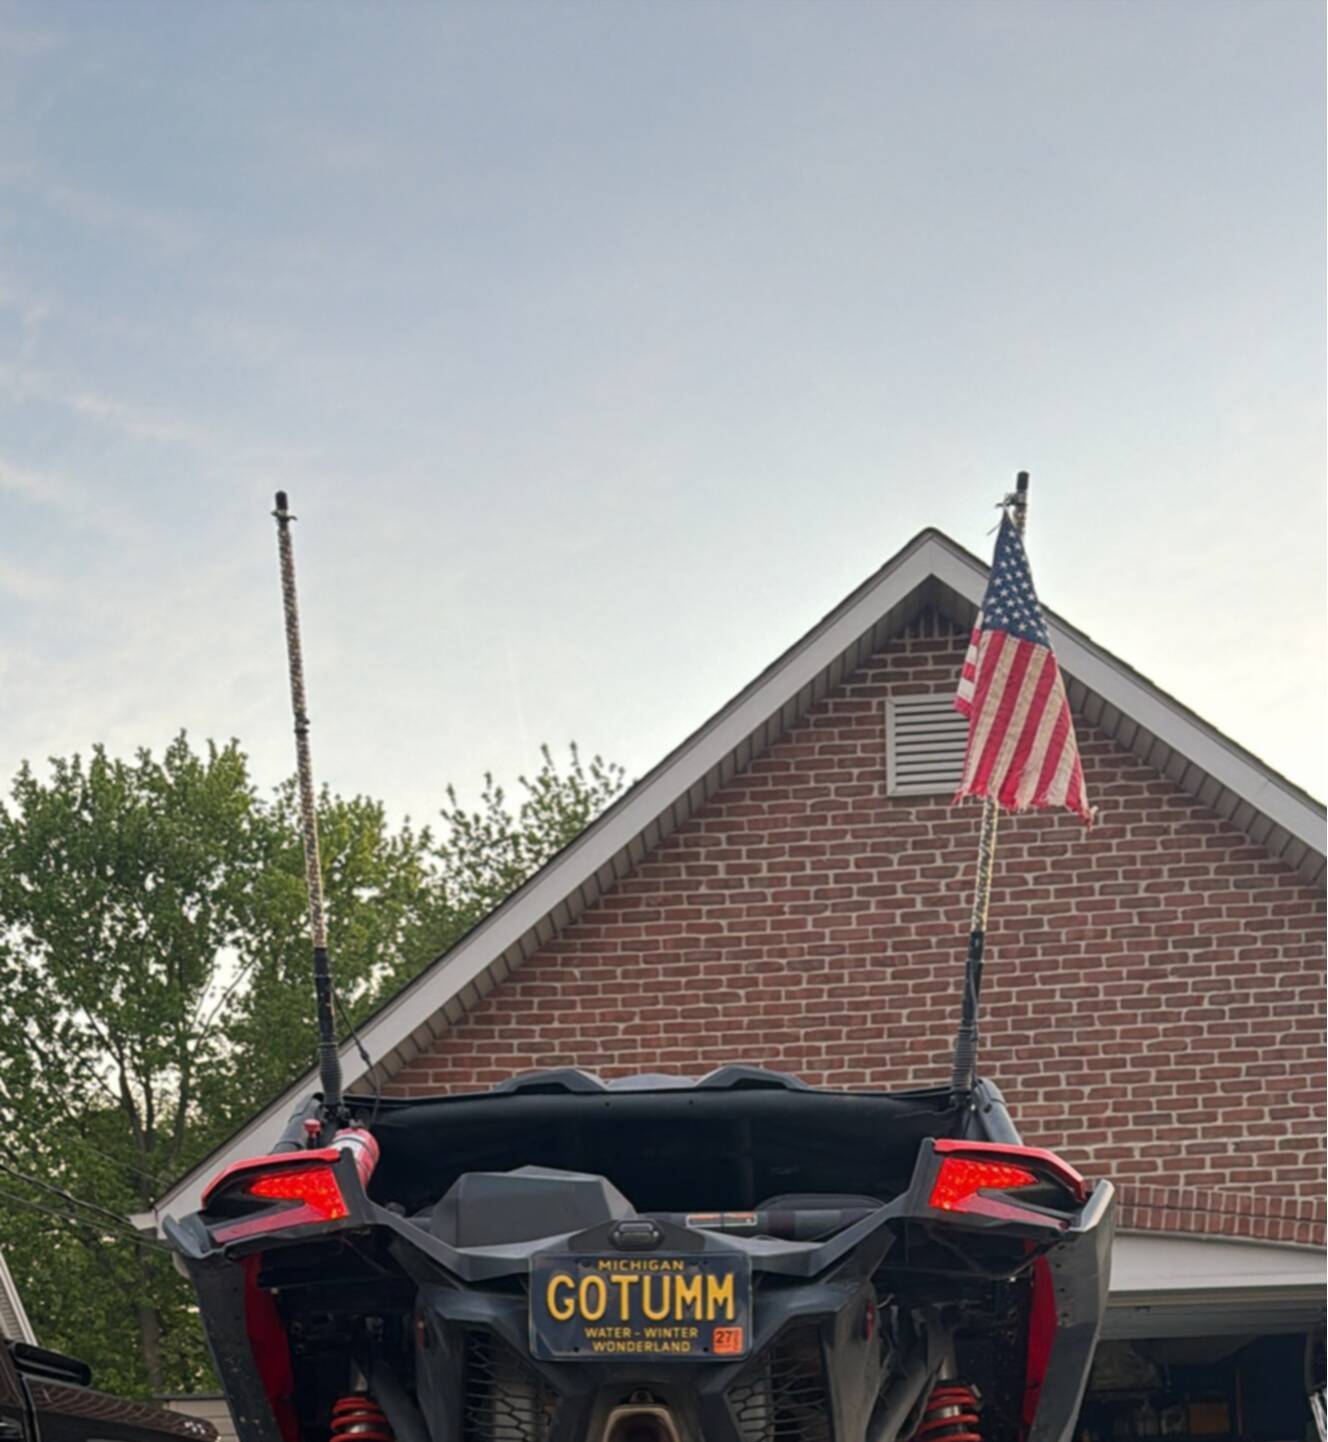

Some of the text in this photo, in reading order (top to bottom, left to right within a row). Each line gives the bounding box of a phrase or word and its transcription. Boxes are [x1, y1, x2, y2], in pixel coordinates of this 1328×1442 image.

[598, 1260, 684, 1271] MICHIGAN
[546, 1274, 735, 1321] GOTUMM
[585, 1328, 632, 1338] WATER
[644, 1328, 698, 1338] WINTER
[716, 1331, 732, 1343] 27
[593, 1341, 691, 1352] WONDERLAND
